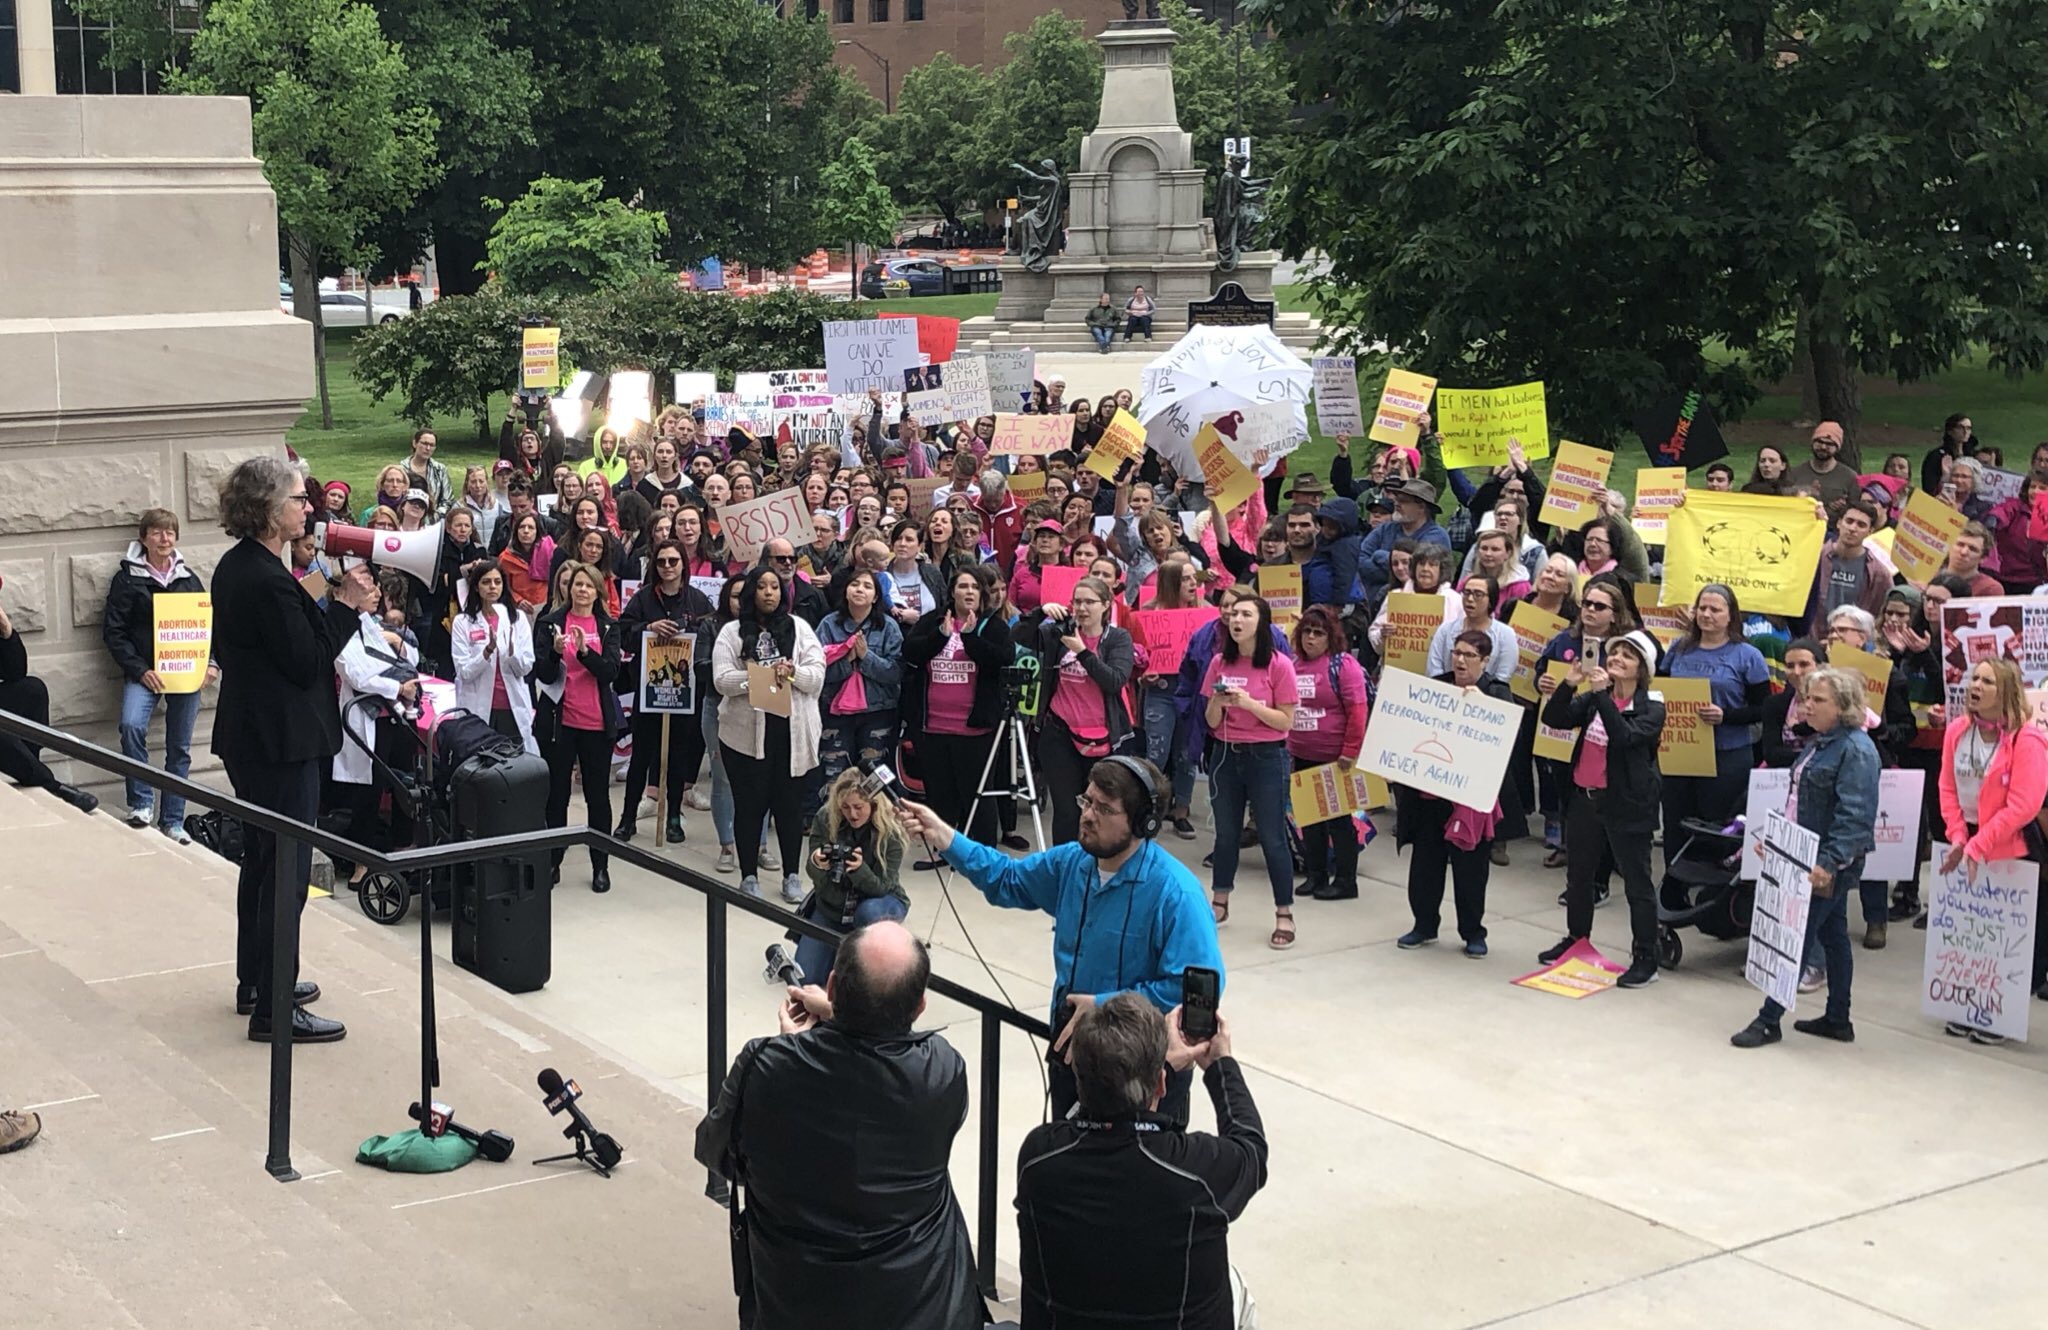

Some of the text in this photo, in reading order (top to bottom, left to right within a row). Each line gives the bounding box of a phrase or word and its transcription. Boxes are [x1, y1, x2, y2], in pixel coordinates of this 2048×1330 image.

[848, 343, 870, 361] CAN
[862, 359, 884, 376] DO
[1461, 395, 1491, 409] MEN
[1004, 417, 1074, 432] I SAY
[993, 434, 1069, 450] ROE WAY
[725, 494, 804, 548] RESIST
[1831, 571, 1856, 582] ACLU
[158, 619, 206, 630] ABORTION IS
[1142, 614, 1171, 632] THIS
[1387, 639, 1406, 651] FOR
[159, 649, 206, 660] ABORTION IS
[160, 662, 167, 672] A
[932, 661, 974, 670] HOOSIER
[933, 672, 967, 682] RIGHTS
[1408, 683, 1507, 727] WOMEN DEMAND
[1380, 700, 1453, 737] REPRODUCTIVE
[1541, 727, 1548, 736] A
[1379, 753, 1471, 790] NEVER AGAIN!
